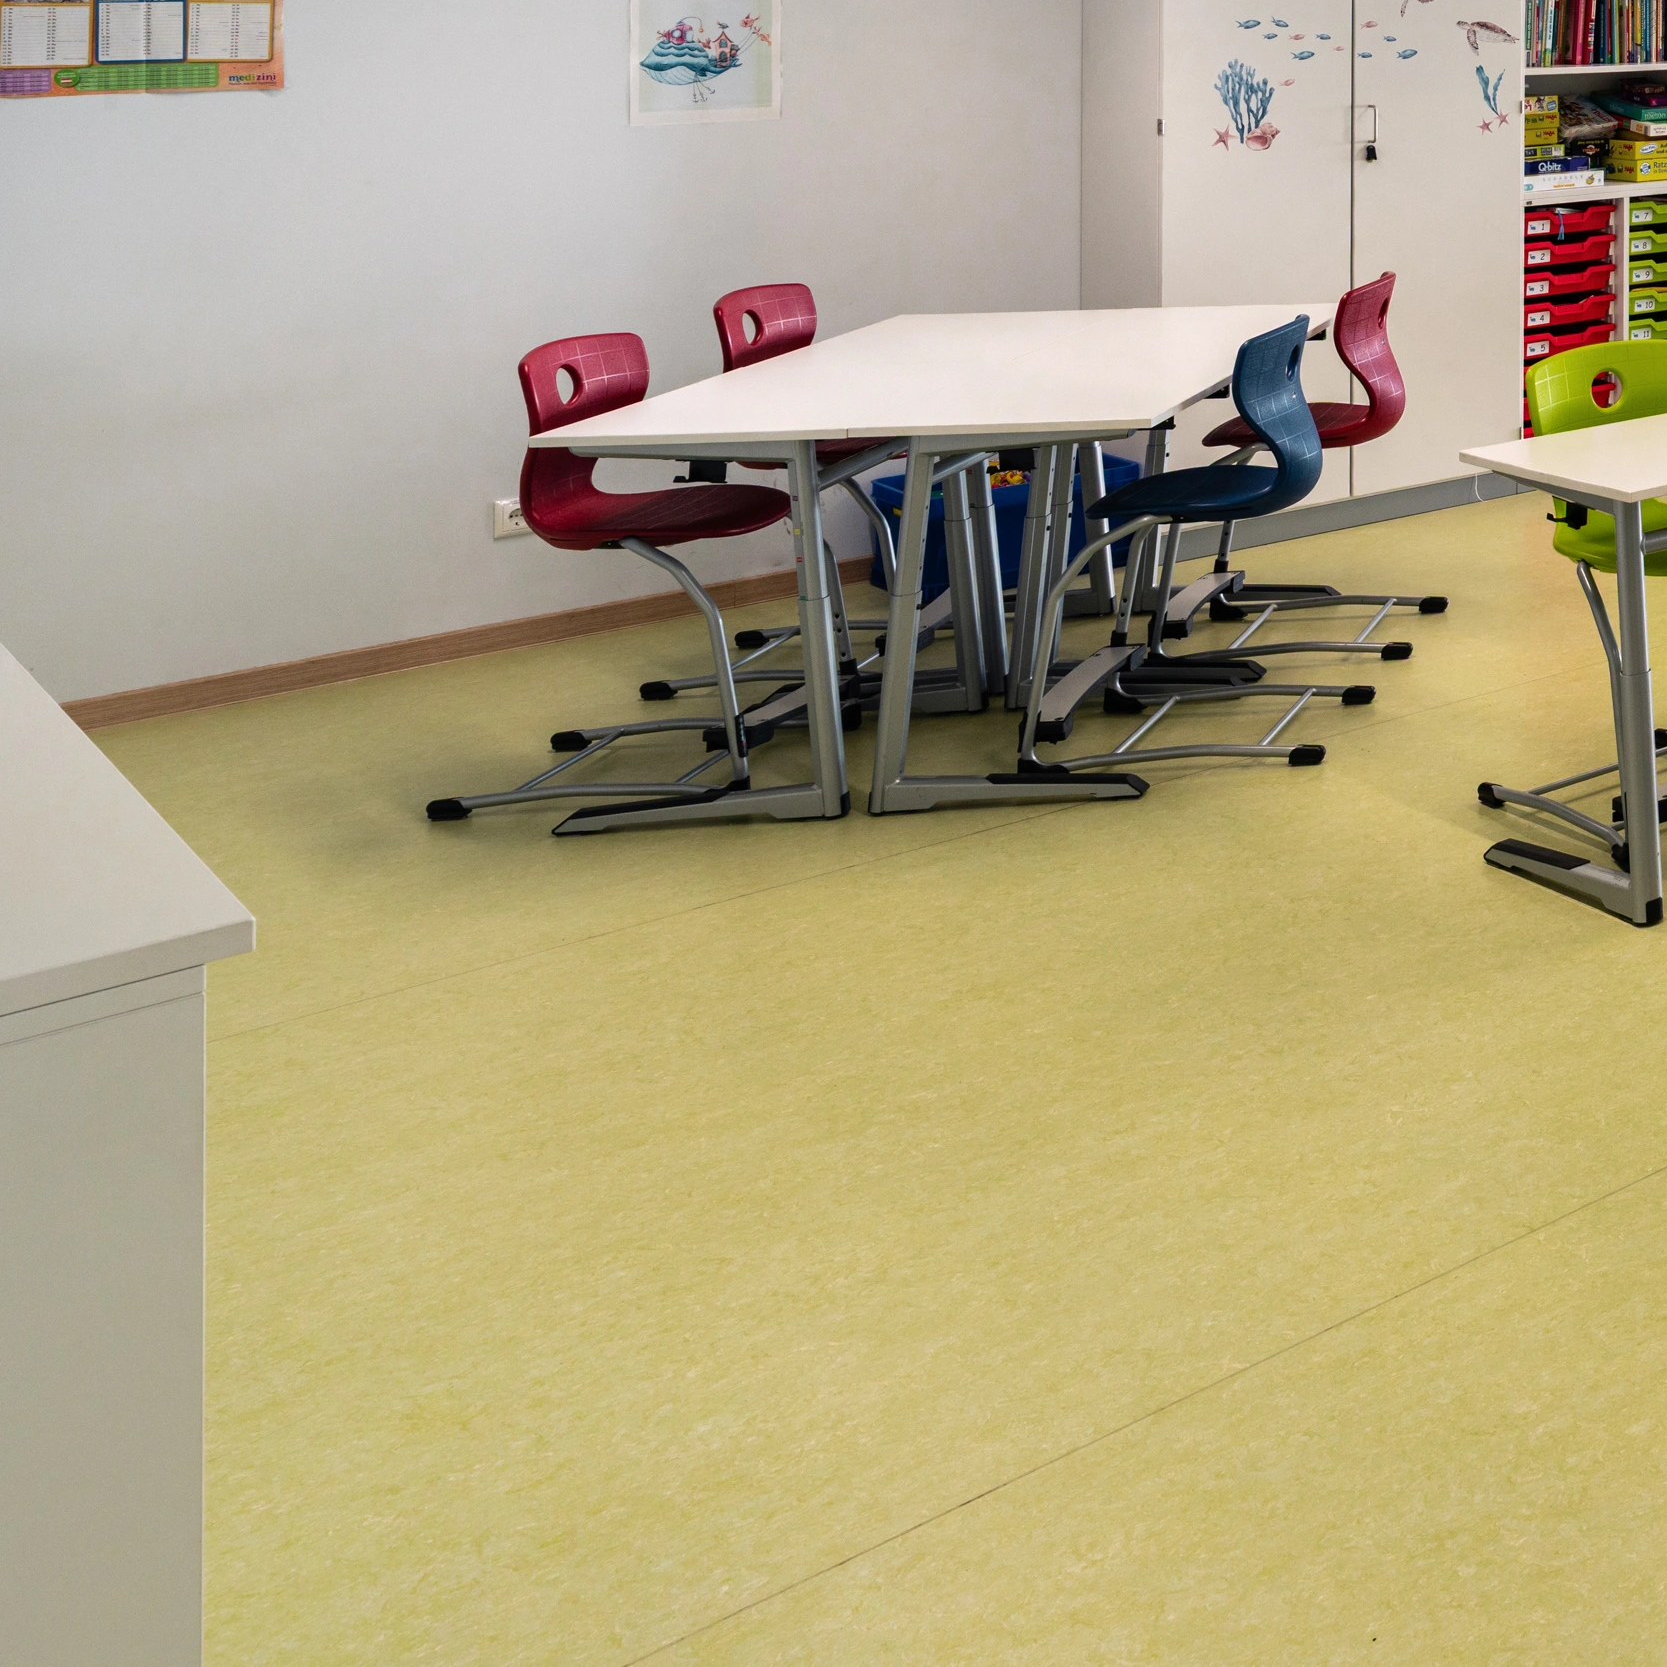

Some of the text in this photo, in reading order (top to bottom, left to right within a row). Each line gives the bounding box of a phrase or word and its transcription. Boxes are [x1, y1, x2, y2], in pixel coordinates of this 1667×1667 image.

[228, 72, 277, 84] medizini
[1653, 161, 1667, 169] Ratz
[1643, 212, 1649, 220] 7
[1541, 223, 1545, 231] 1
[1642, 241, 1648, 249] 8
[1540, 253, 1546, 261] 2
[1539, 284, 1545, 292] 3
[1645, 300, 1653, 309] 10
[1539, 314, 1545, 322] 4
[1643, 330, 1650, 338] 11
[1540, 344, 1546, 352] 5
